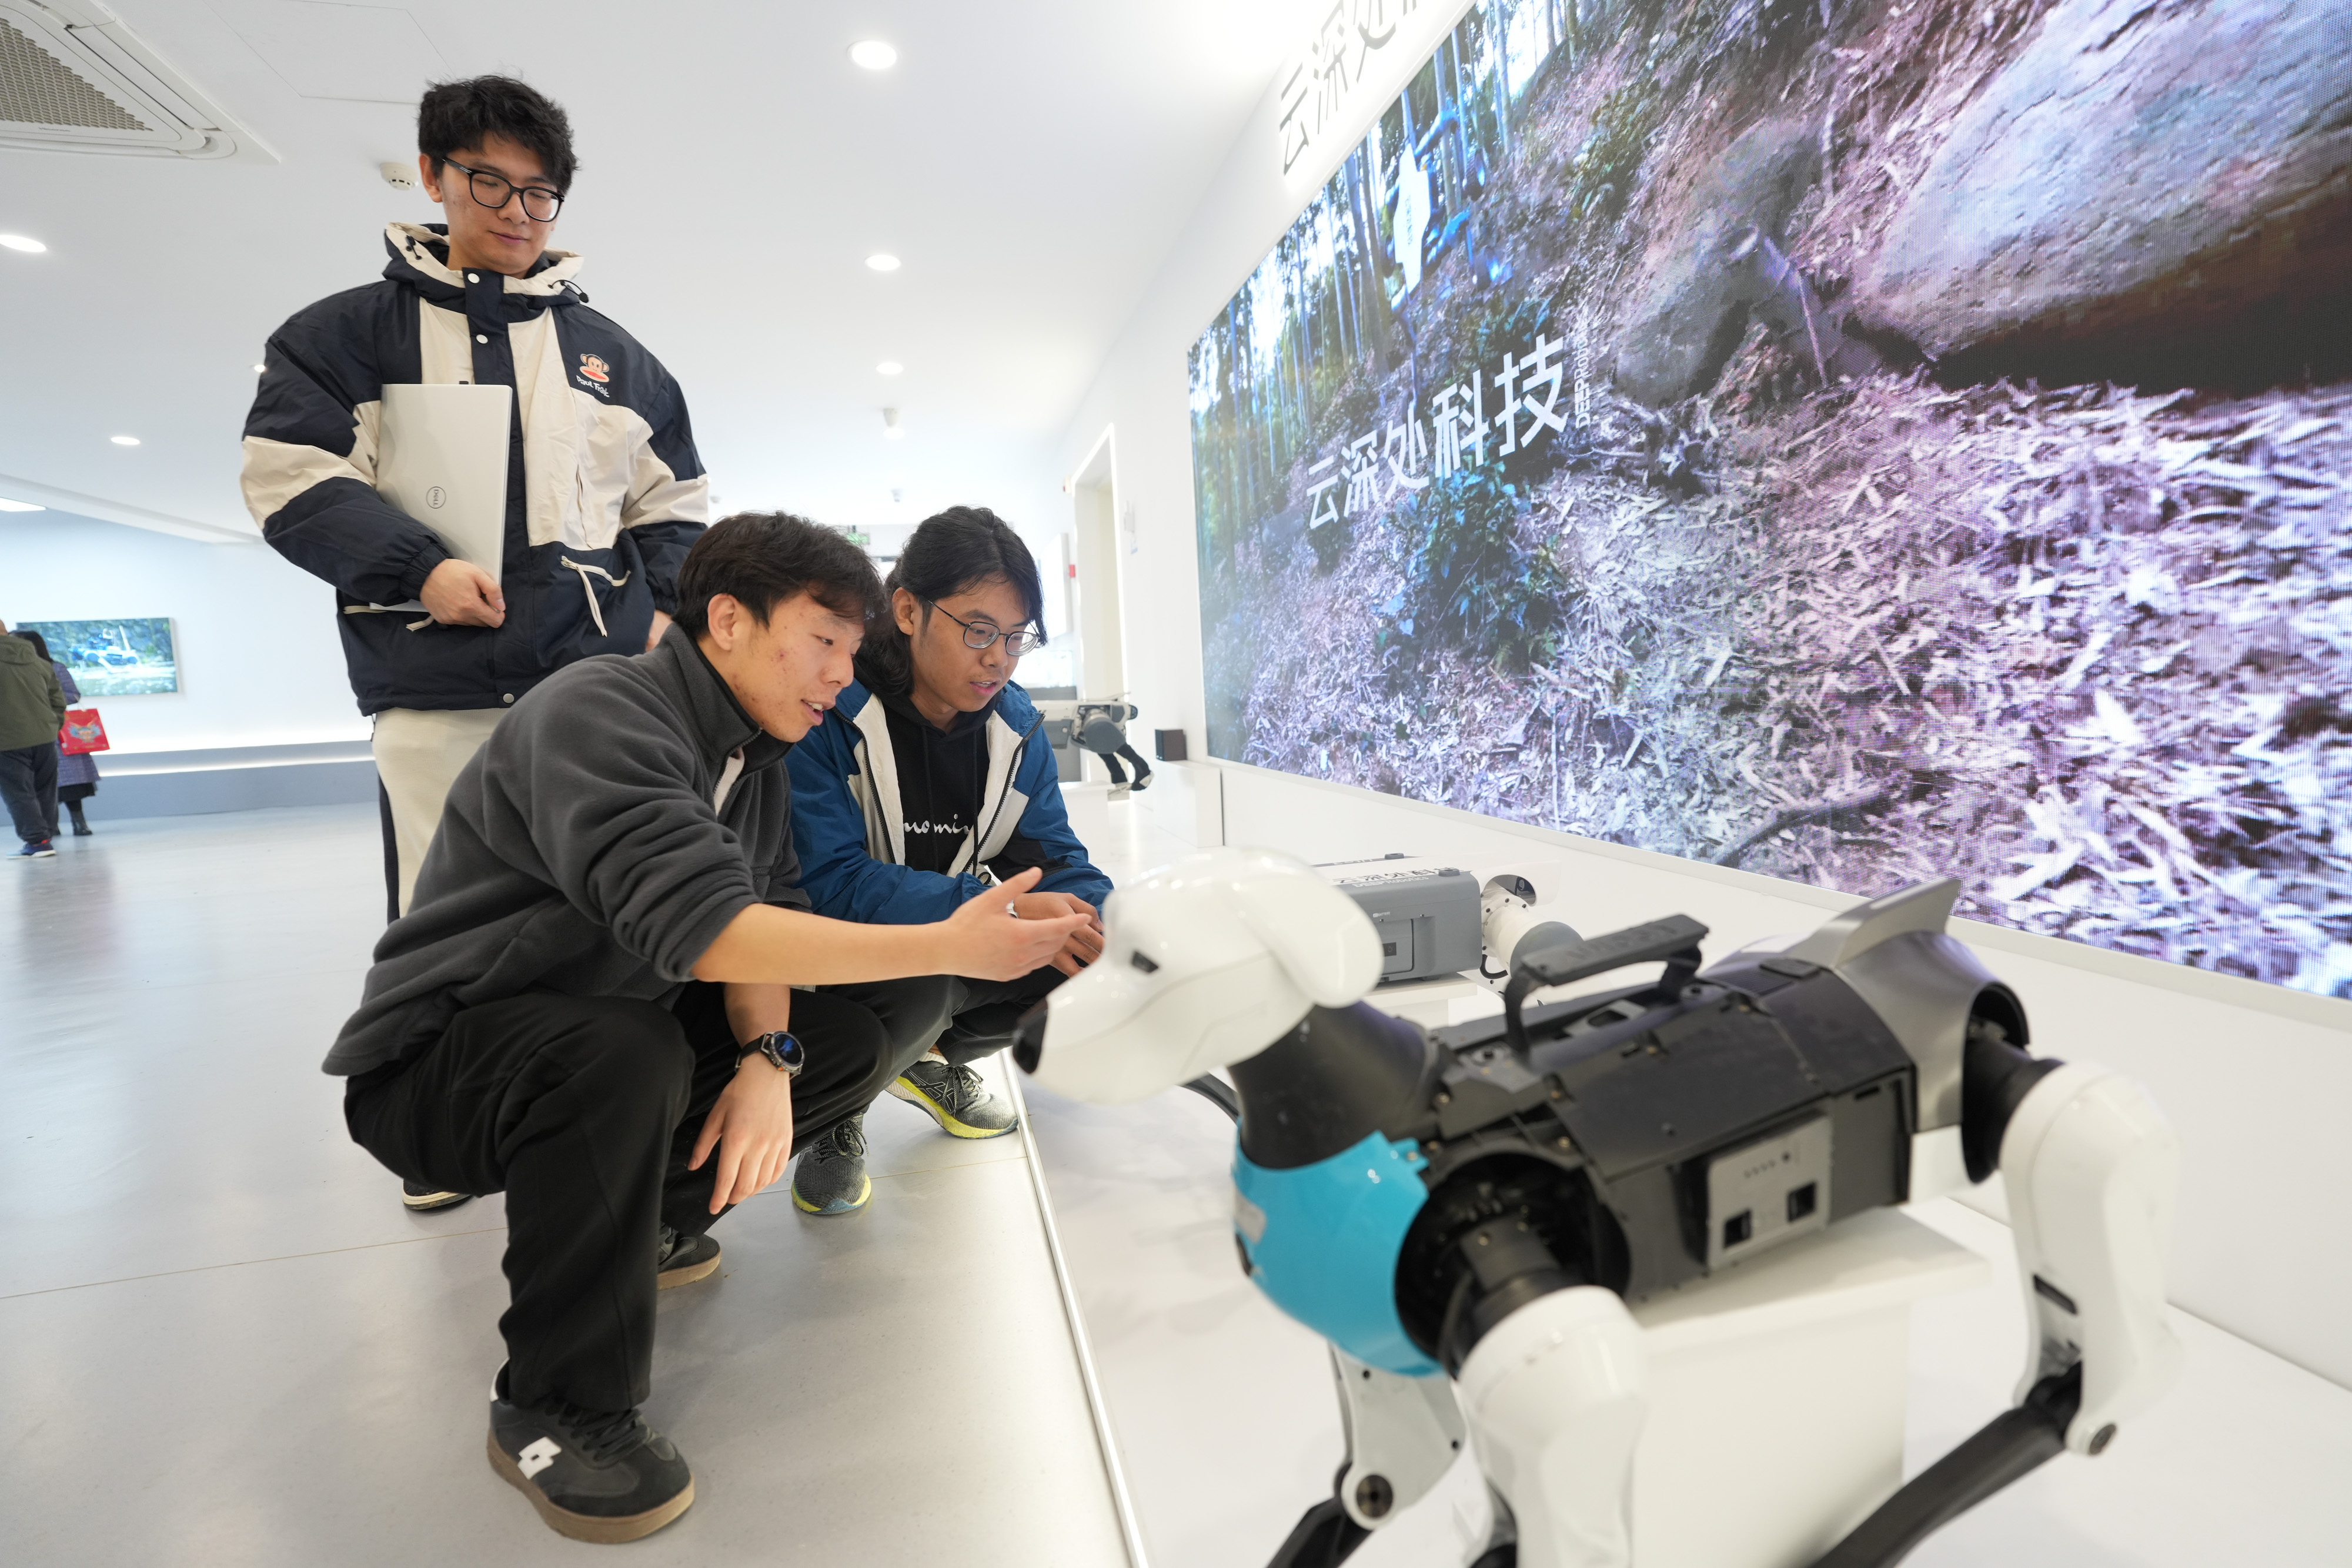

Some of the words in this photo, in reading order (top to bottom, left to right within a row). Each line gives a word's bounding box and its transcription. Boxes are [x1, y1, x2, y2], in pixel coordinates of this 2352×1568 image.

[1307, 333, 1569, 530] 云深处科技
